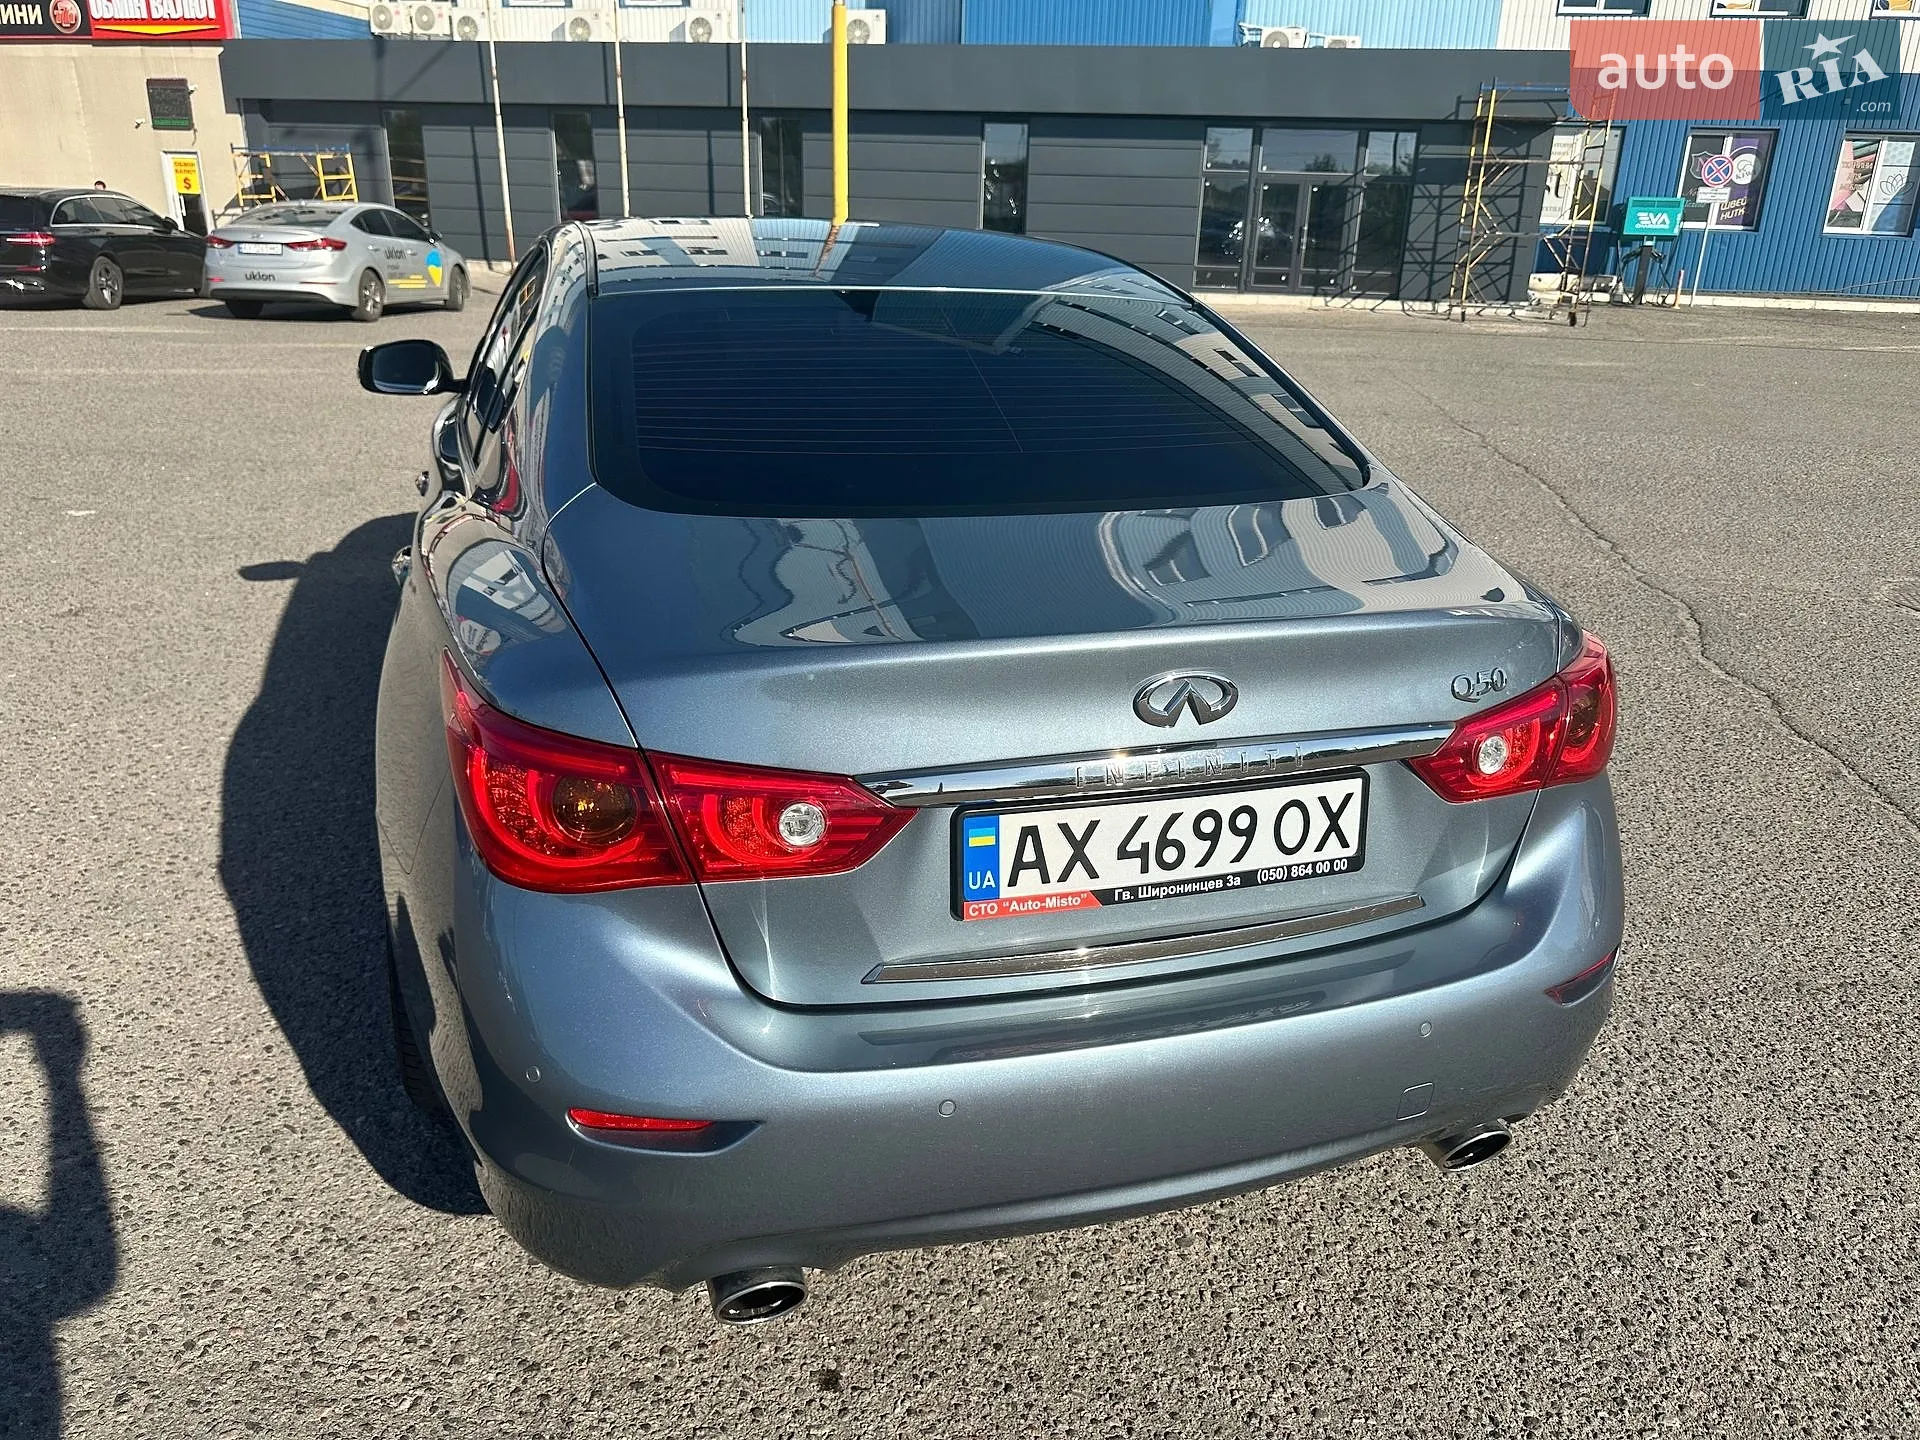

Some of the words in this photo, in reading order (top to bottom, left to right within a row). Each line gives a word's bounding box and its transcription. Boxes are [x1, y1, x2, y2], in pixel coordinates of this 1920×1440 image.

[0, 4, 43, 25] ИНИ
[1637, 211, 1671, 226] EVA
[244, 271, 276, 282] uklon
[1450, 667, 1508, 703] Q50
[1075, 742, 1304, 789] INFINITI
[1007, 819, 1100, 888] AX
[1117, 804, 1258, 875] 4699
[1273, 791, 1355, 856] OX
[968, 870, 996, 890] UA
[1114, 888, 1135, 902] Гв.
[1138, 879, 1223, 899] Широнинцев
[1256, 865, 1288, 885] (050)
[1290, 864, 1313, 878] 864
[1316, 860, 1331, 874] 00
[1333, 858, 1348, 872] 00
[968, 902, 998, 917] СТО
